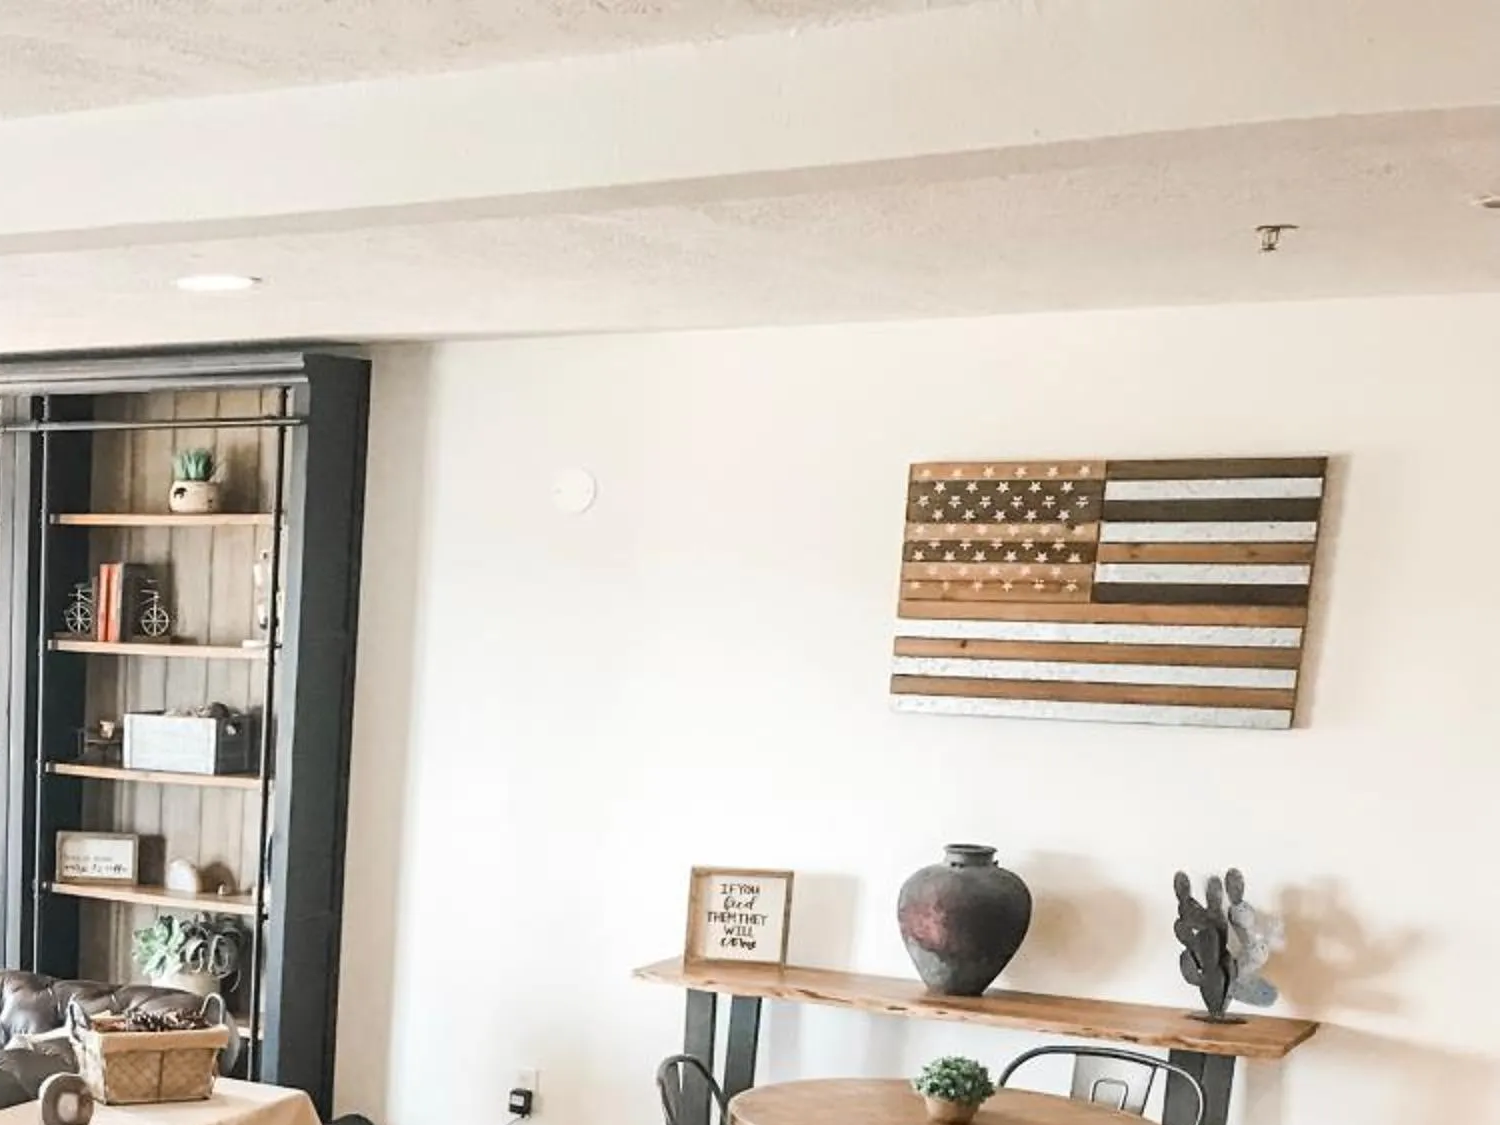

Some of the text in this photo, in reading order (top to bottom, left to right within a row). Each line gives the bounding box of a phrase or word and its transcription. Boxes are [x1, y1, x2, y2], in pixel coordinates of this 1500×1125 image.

[720, 883, 760, 895] IF YOU
[707, 911, 768, 926] THEM THEY
[723, 924, 754, 937] WILL
